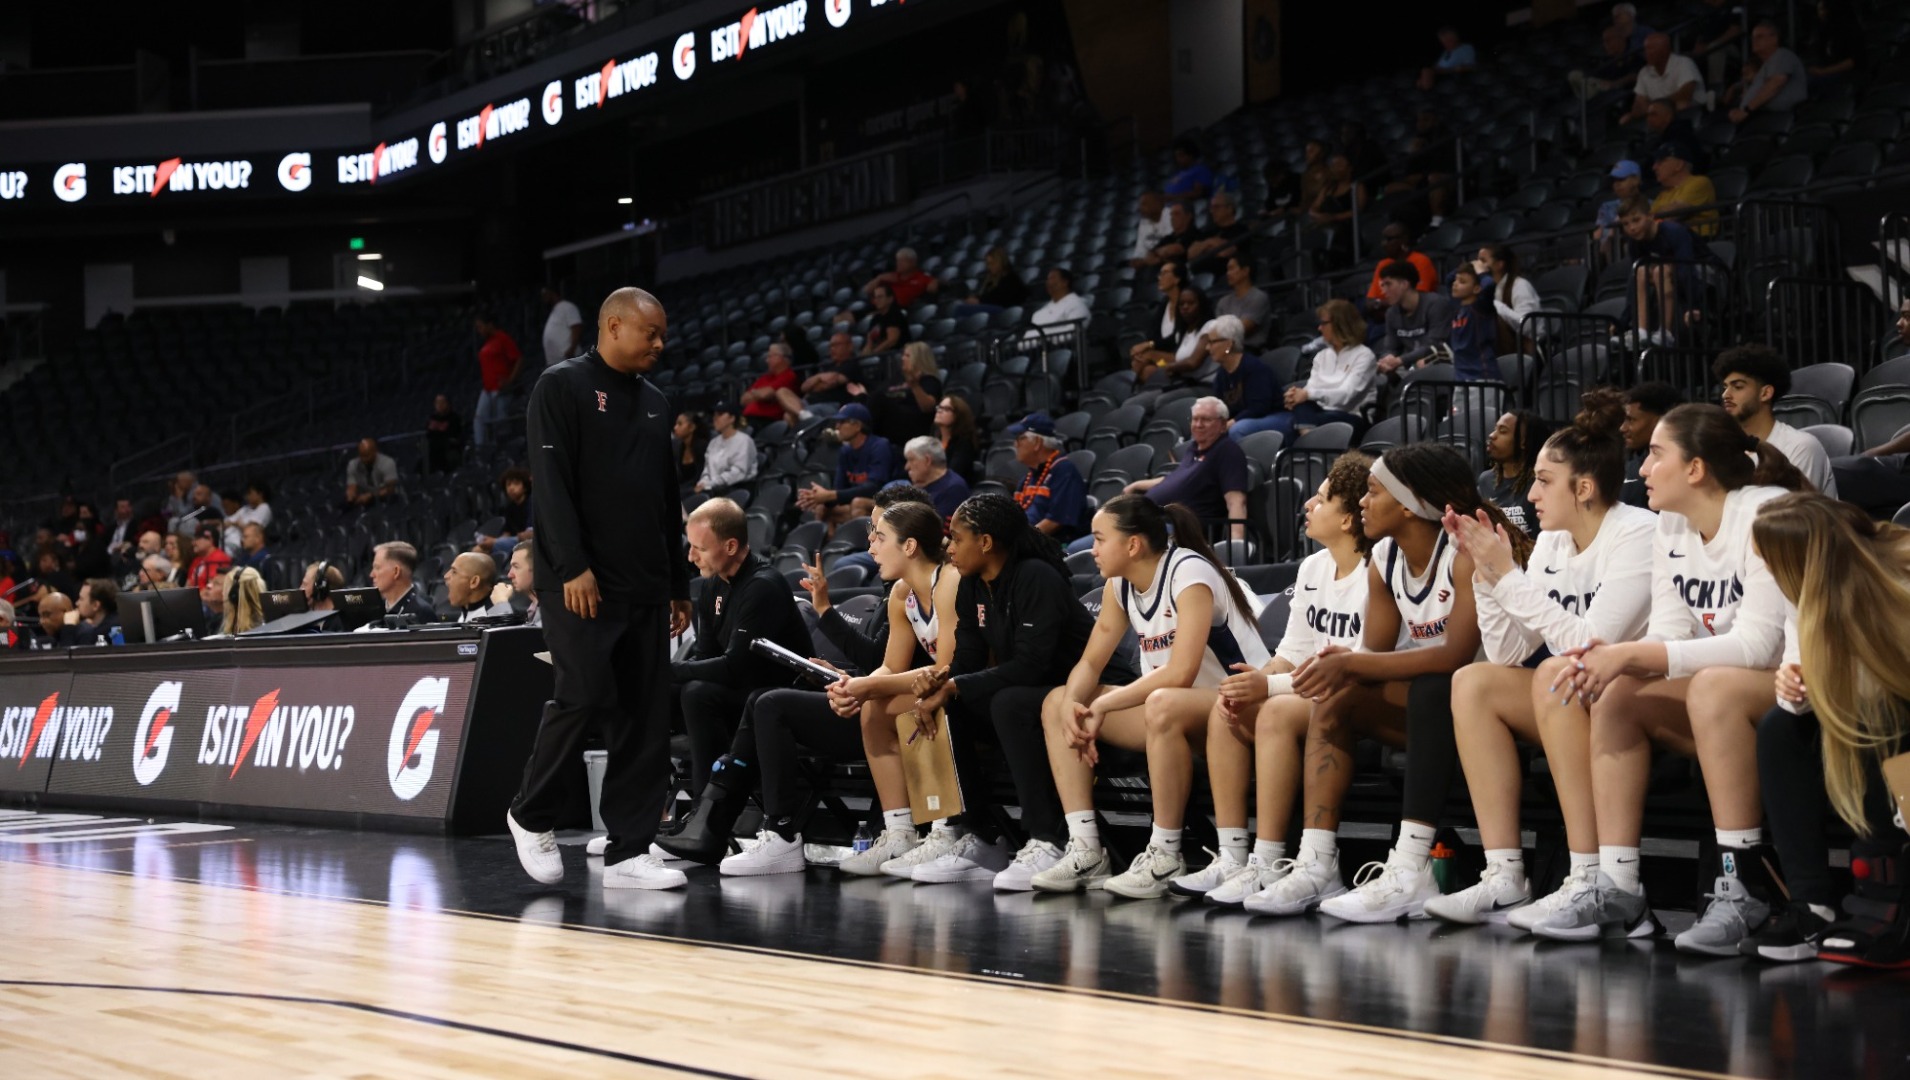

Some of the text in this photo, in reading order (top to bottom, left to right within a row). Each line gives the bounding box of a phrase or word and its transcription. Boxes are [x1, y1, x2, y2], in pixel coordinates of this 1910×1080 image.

[0, 171, 28, 199] U?
[595, 390, 608, 412] F
[1672, 574, 1716, 609] OCK
[133, 681, 183, 785] G
[387, 675, 450, 801] G
